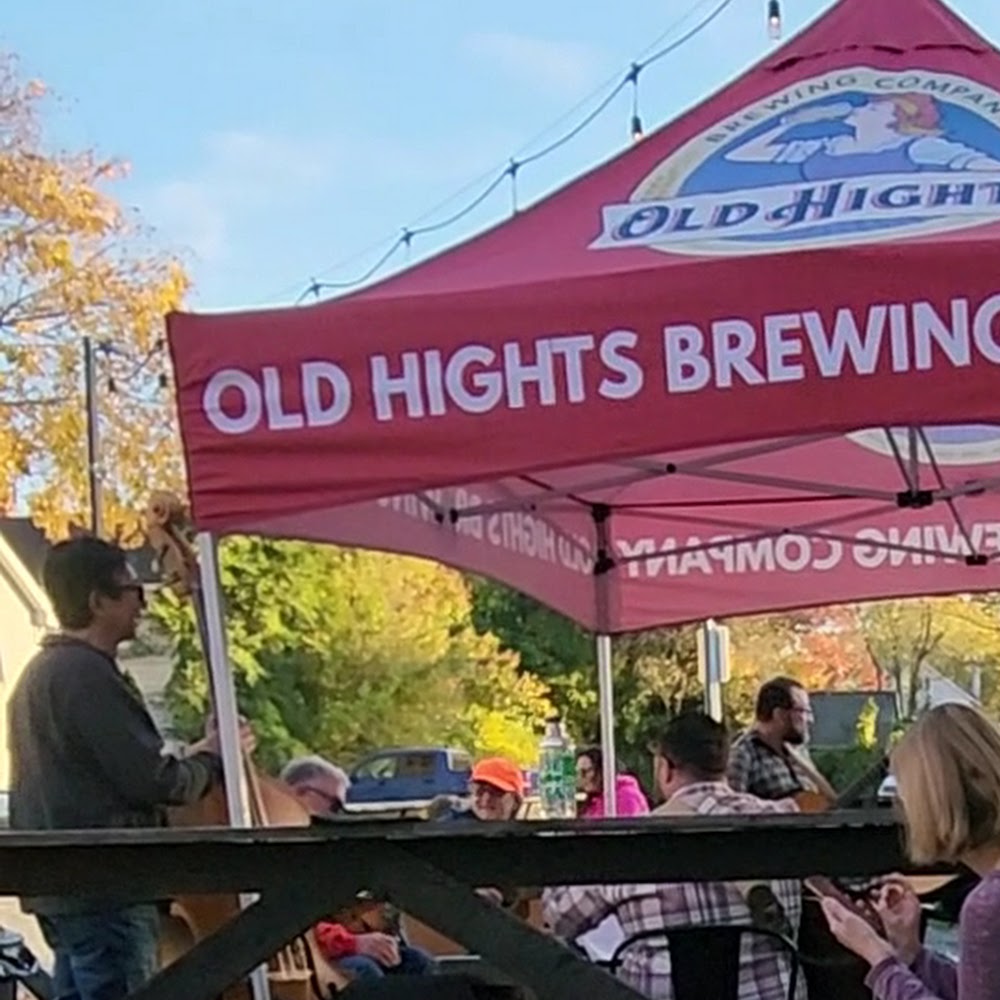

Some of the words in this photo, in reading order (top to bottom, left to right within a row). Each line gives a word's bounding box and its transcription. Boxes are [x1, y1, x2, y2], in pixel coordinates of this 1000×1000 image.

[706, 75, 857, 144] BREWING
[612, 202, 760, 241] OLD
[203, 361, 351, 433] OLD
[370, 329, 643, 421] HIGHTS
